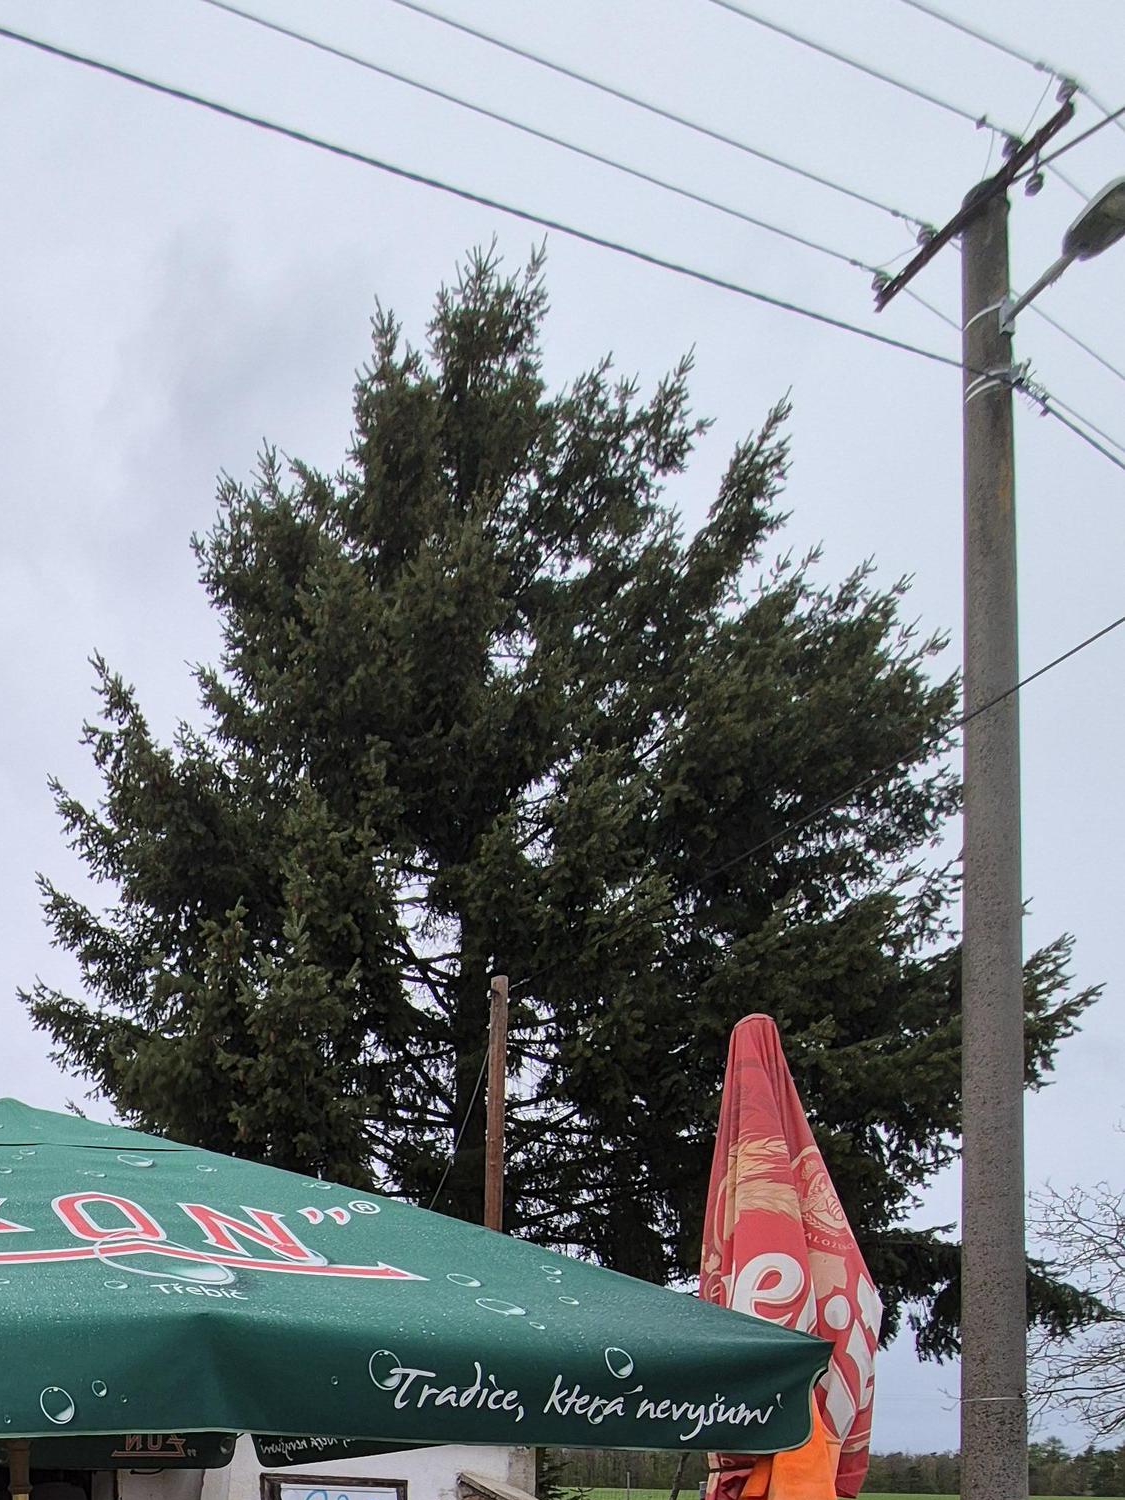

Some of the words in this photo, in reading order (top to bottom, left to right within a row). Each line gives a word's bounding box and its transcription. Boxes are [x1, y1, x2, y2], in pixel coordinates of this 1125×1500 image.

[390, 1361, 524, 1422] Tradice,
[543, 1374, 642, 1421] která
[638, 1392, 784, 1442] nevyšumí
